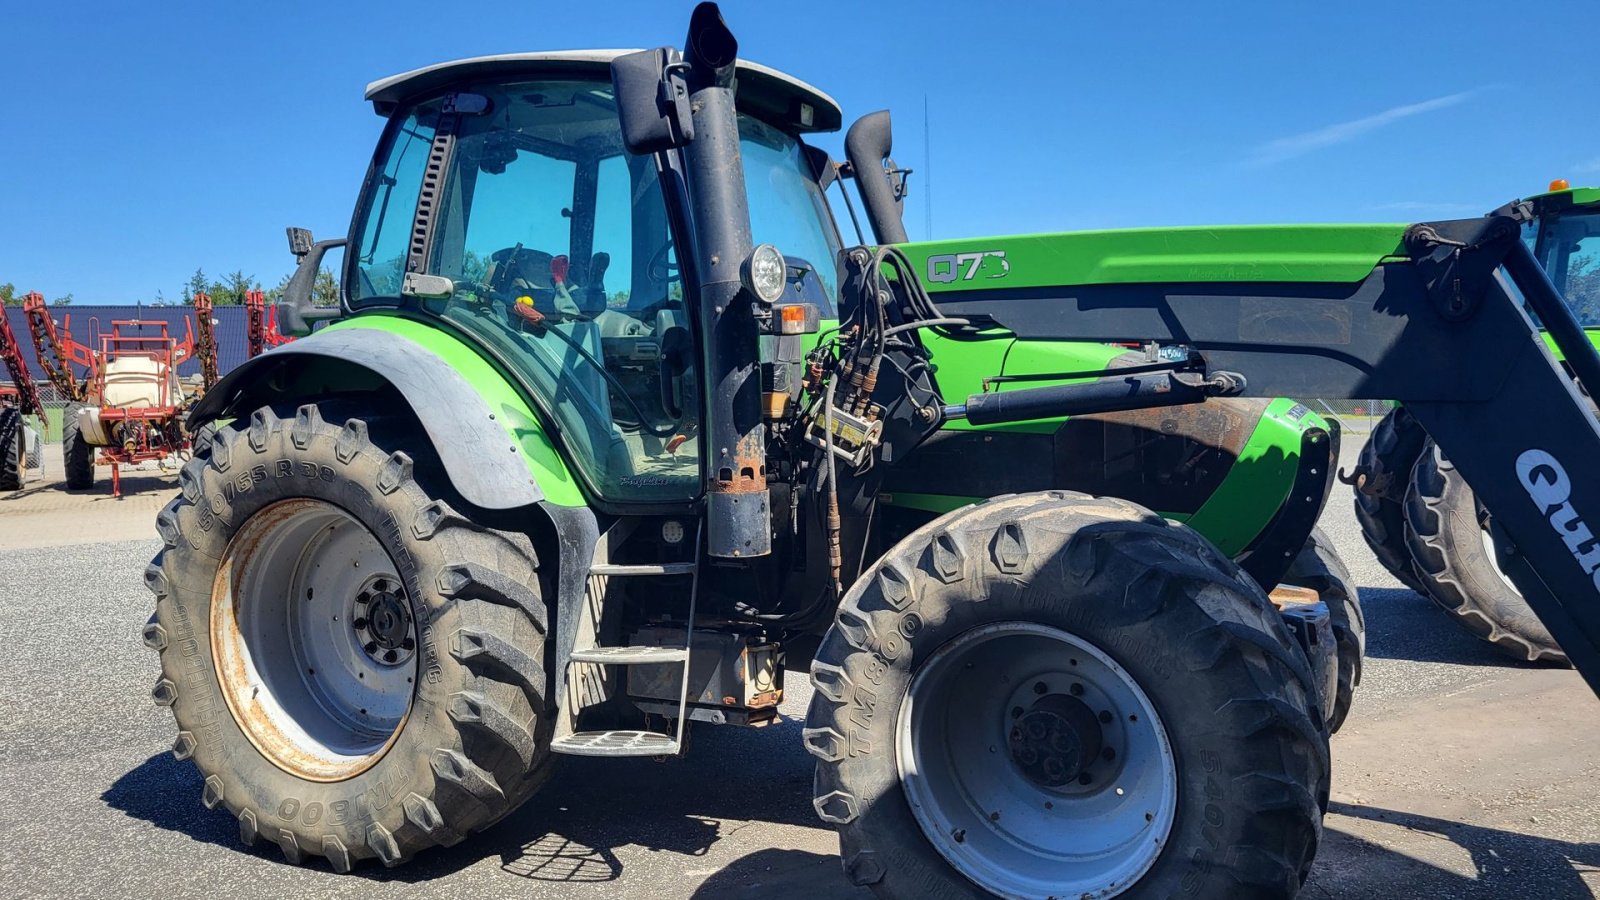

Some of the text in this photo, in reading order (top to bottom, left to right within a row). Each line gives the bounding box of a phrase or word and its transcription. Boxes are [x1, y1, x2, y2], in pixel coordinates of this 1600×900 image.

[188, 458, 337, 550] 650/65 R 38
[172, 604, 226, 761] TRELLEBORG
